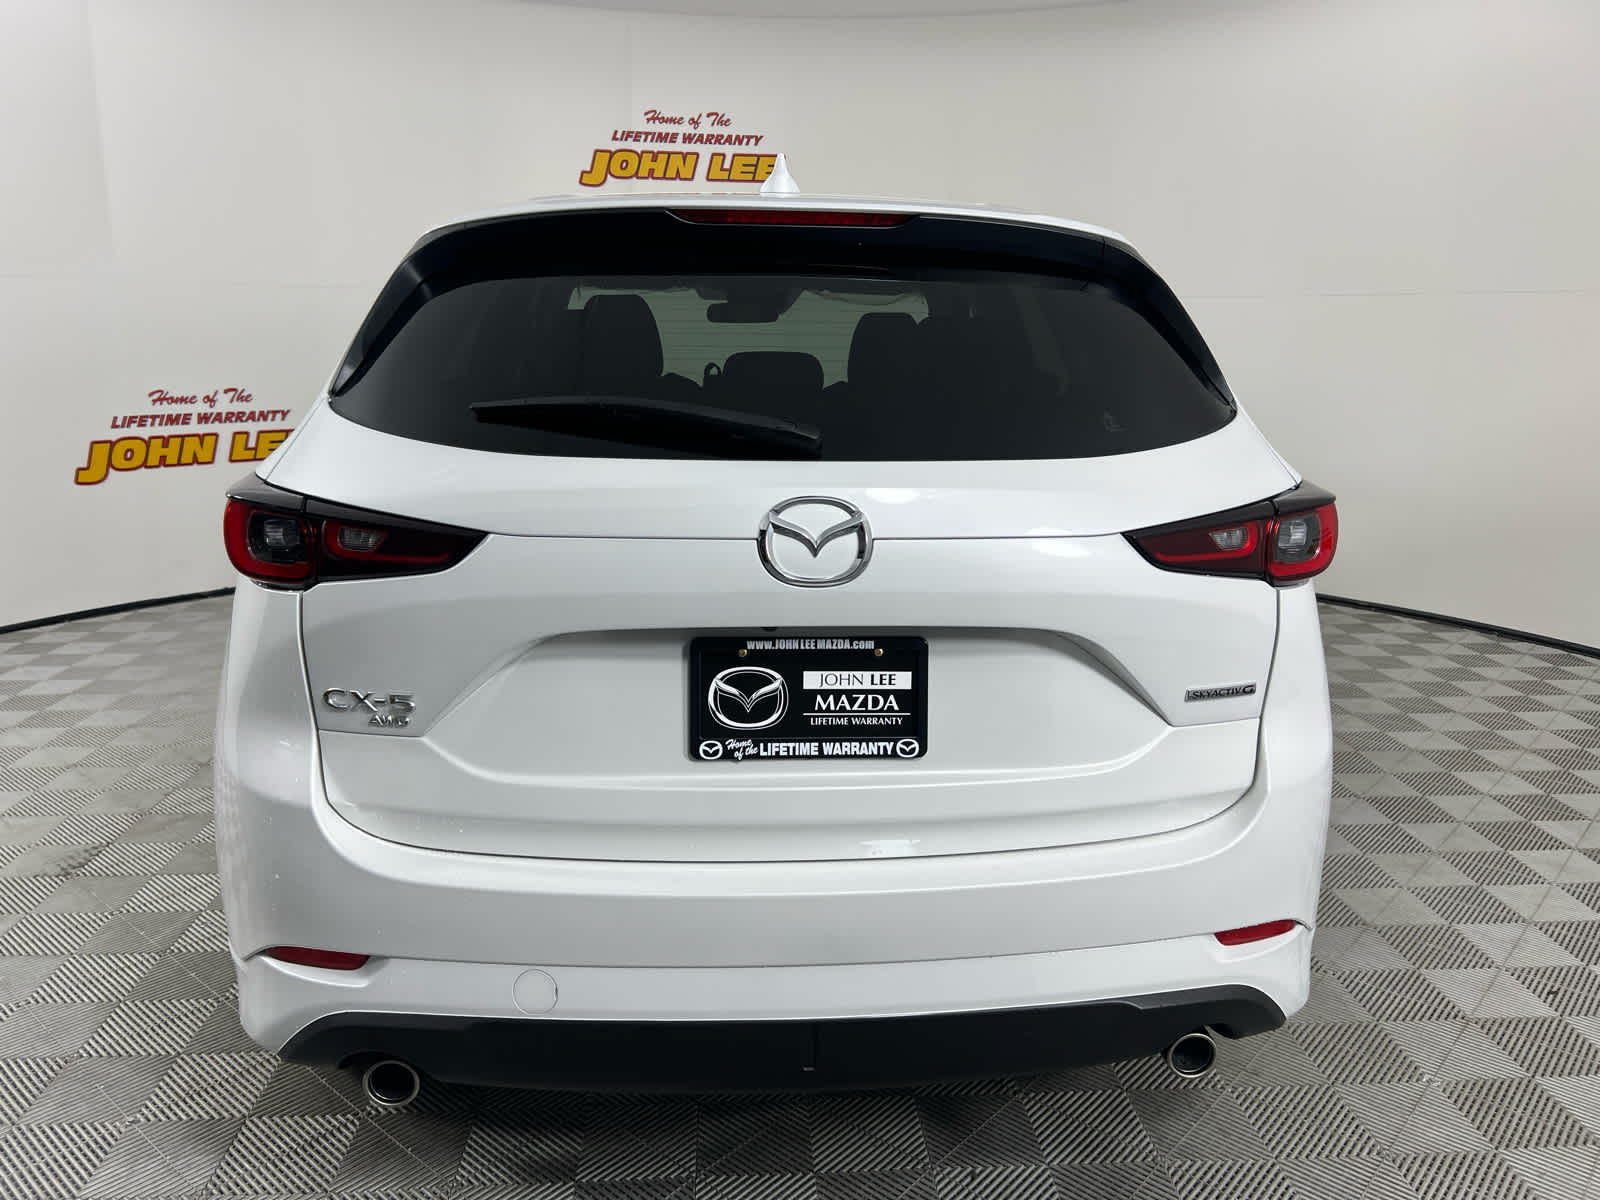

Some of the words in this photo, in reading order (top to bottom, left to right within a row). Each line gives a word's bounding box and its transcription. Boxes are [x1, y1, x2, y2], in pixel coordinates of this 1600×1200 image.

[644, 109, 685, 126] Home
[688, 112, 702, 130] of
[706, 111, 733, 127] The
[611, 130, 679, 145] LIFETIME
[682, 132, 763, 147] WARRANTY
[579, 148, 699, 188] JOHN
[148, 389, 197, 406] Home
[202, 391, 218, 408] of
[223, 387, 254, 404] The
[110, 413, 193, 429] LIFETIME
[196, 409, 291, 425] WARRANTY
[74, 433, 219, 486] JOHN
[228, 428, 295, 463] LE
[819, 673, 864, 688] JOHN
[870, 673, 897, 686] LEE
[323, 687, 416, 713] CX-5
[814, 694, 900, 711] MAZDA
[367, 714, 409, 728] AWD
[810, 717, 849, 726] LIFETIME
[851, 717, 903, 725] WARRANTY
[725, 739, 753, 750] Home
[734, 751, 744, 761] of
[745, 745, 759, 756] the
[760, 742, 819, 756] LIFETIME
[822, 742, 894, 755] WARRANTY
